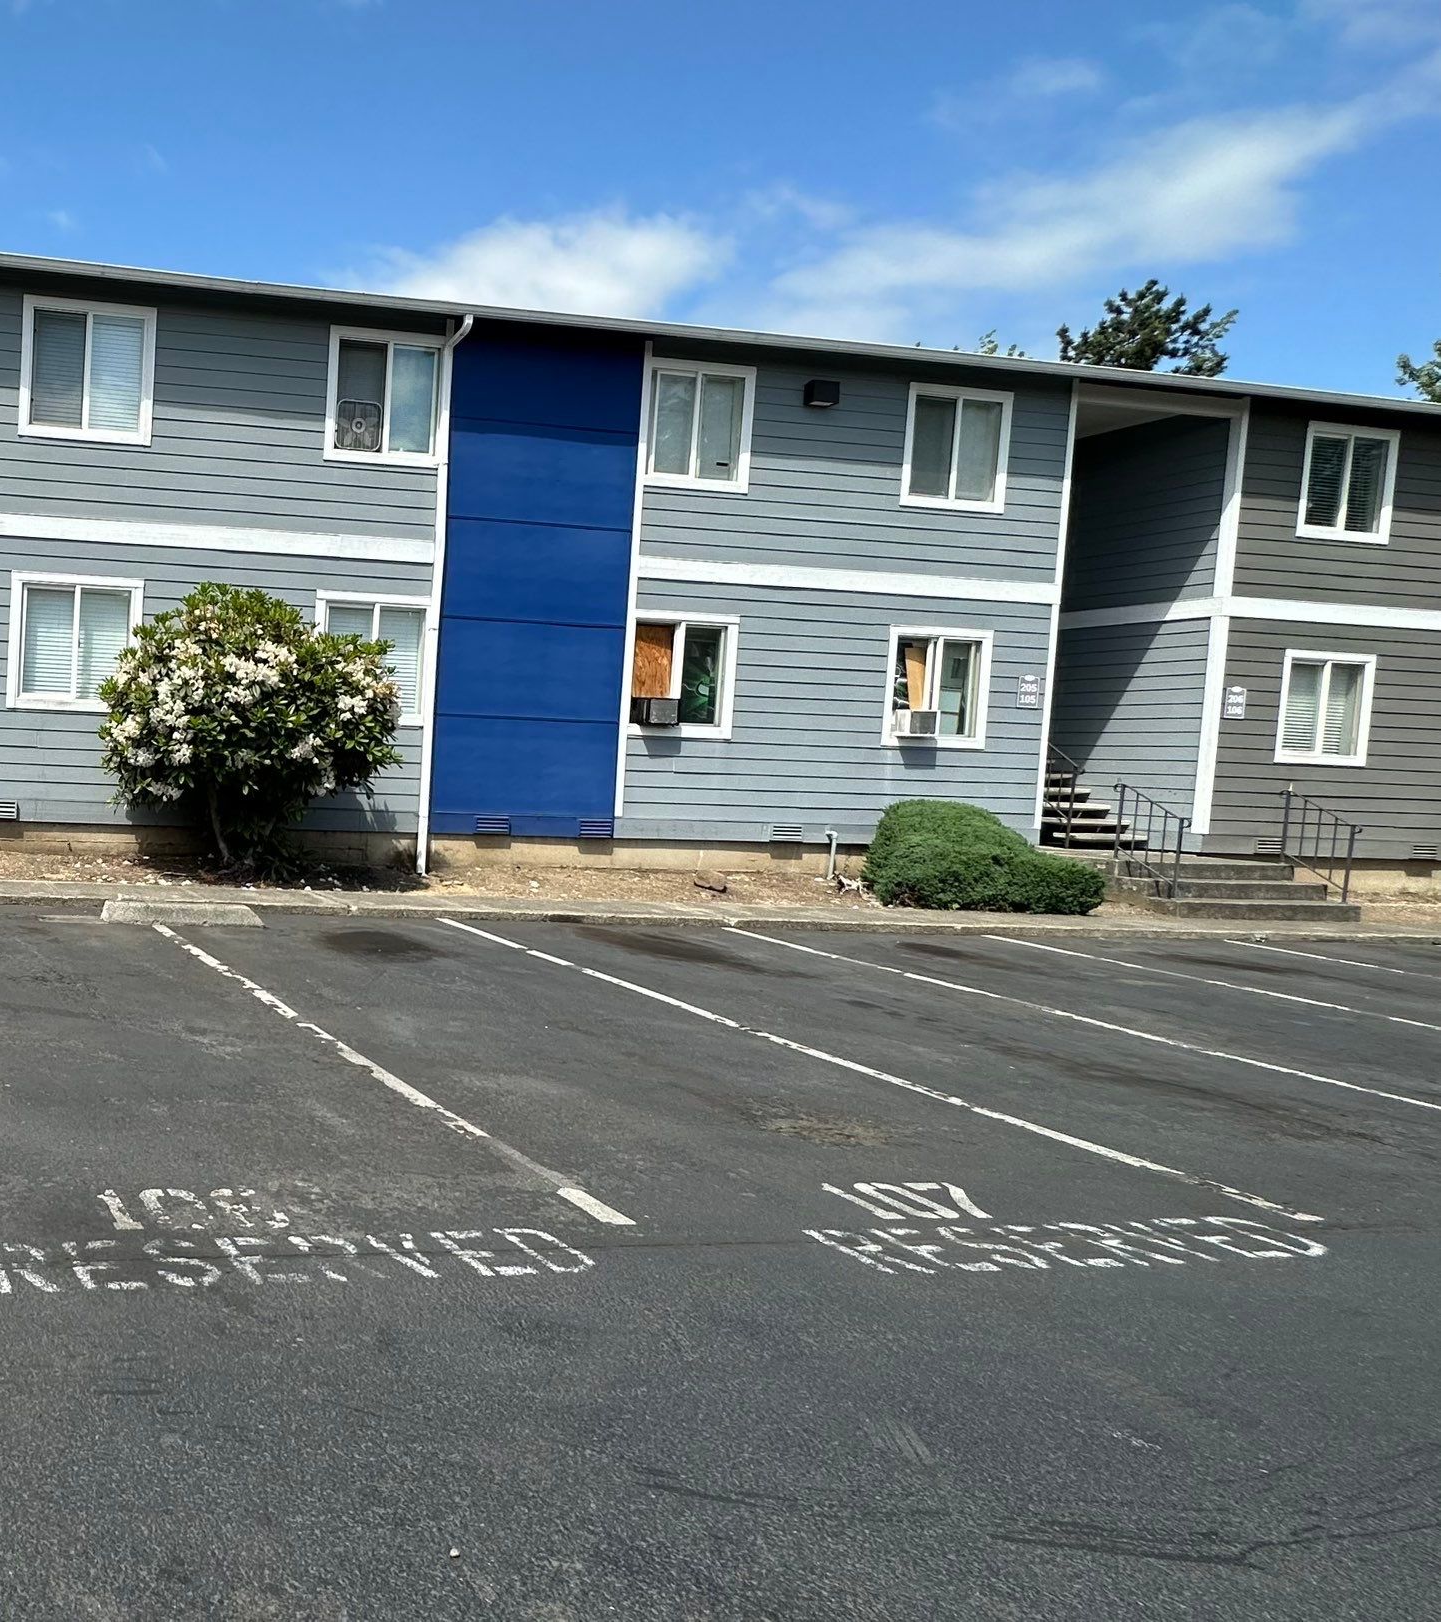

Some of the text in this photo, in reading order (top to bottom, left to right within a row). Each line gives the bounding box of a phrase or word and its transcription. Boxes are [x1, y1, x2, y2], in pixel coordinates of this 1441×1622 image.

[1020, 682, 1038, 692] 205
[1019, 694, 1036, 704] 105
[1227, 694, 1244, 704] 206
[1226, 705, 1243, 715] 106
[820, 1182, 993, 1220] 107
[802, 1215, 1328, 1275] RESERVED
